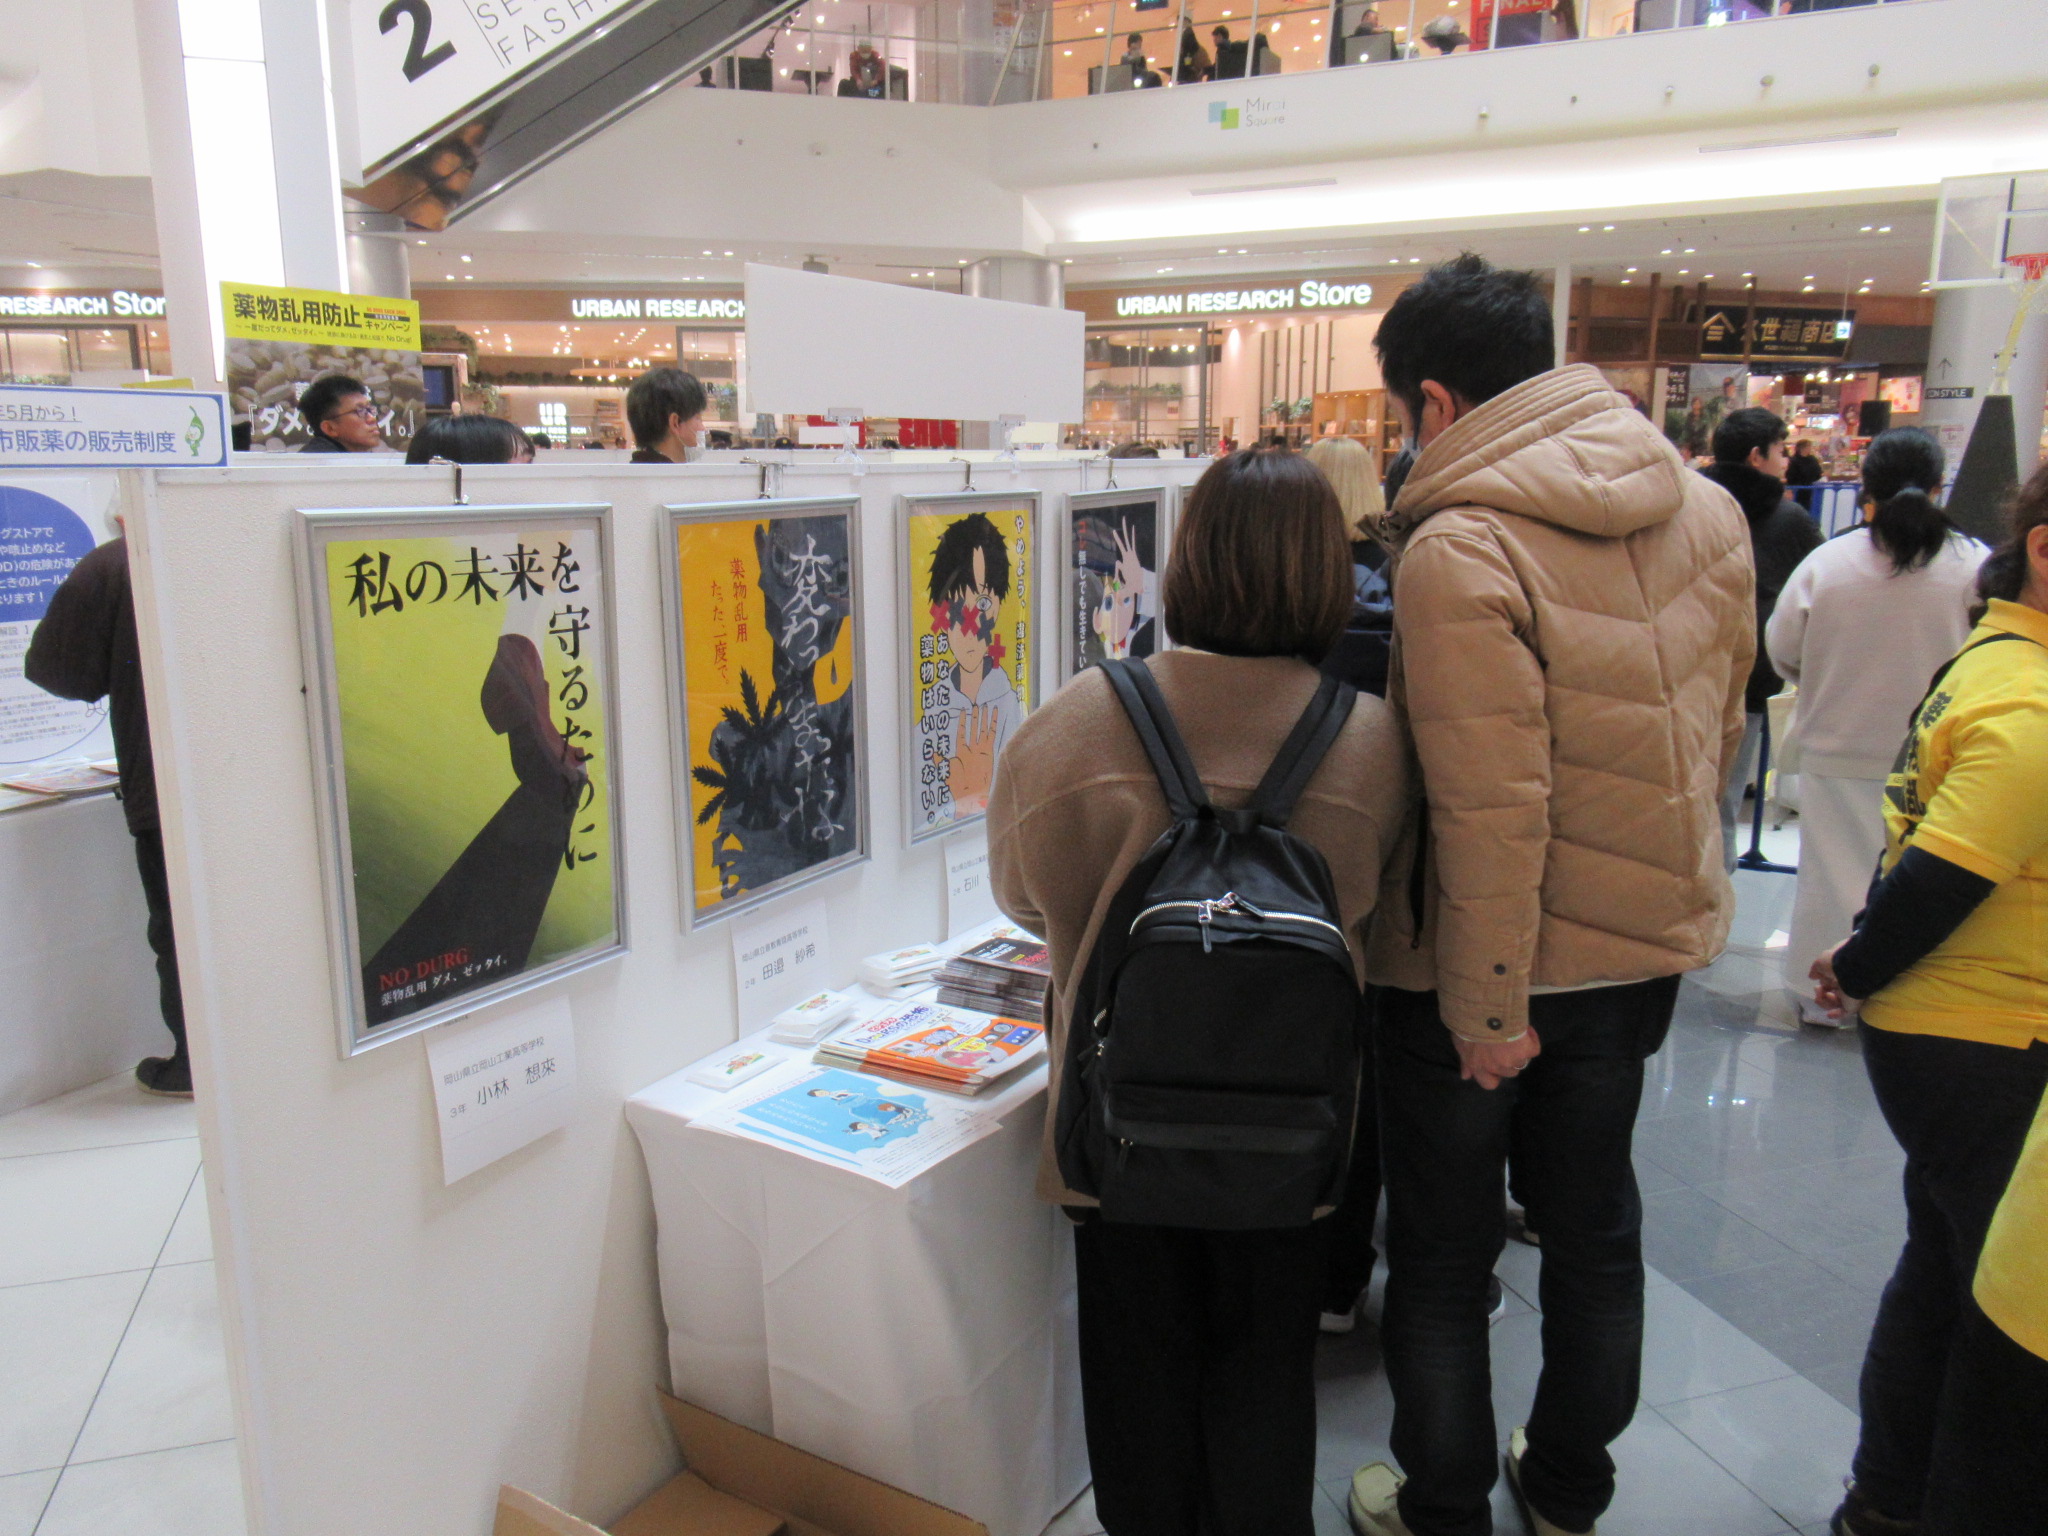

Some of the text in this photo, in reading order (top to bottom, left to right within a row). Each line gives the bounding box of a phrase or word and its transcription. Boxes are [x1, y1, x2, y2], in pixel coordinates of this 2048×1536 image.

[476, 0, 524, 30] SE
[379, 0, 457, 83] 2
[497, 0, 596, 64] FASH
[0, 296, 109, 316] RESEARCH
[233, 292, 363, 328] 薬物乱用防止
[571, 298, 641, 318] URBAN
[1117, 280, 1373, 317] URBAN RESEARCH Store
[365, 319, 411, 333] キャンペーン
[0, 405, 77, 422] 5月から！
[0, 557, 83, 573] D)の危険があ
[0, 574, 69, 589] ときのルール
[344, 541, 581, 618] 私の未来を
[730, 558, 748, 643] 薬物乱用
[920, 633, 936, 824] 薬物はいらない。
[963, 873, 980, 892] 石川
[379, 947, 470, 992] NO DURG
[381, 980, 428, 1007] 薬物乱用
[449, 1102, 468, 1119] 3年
[476, 1076, 511, 1106] 小林
